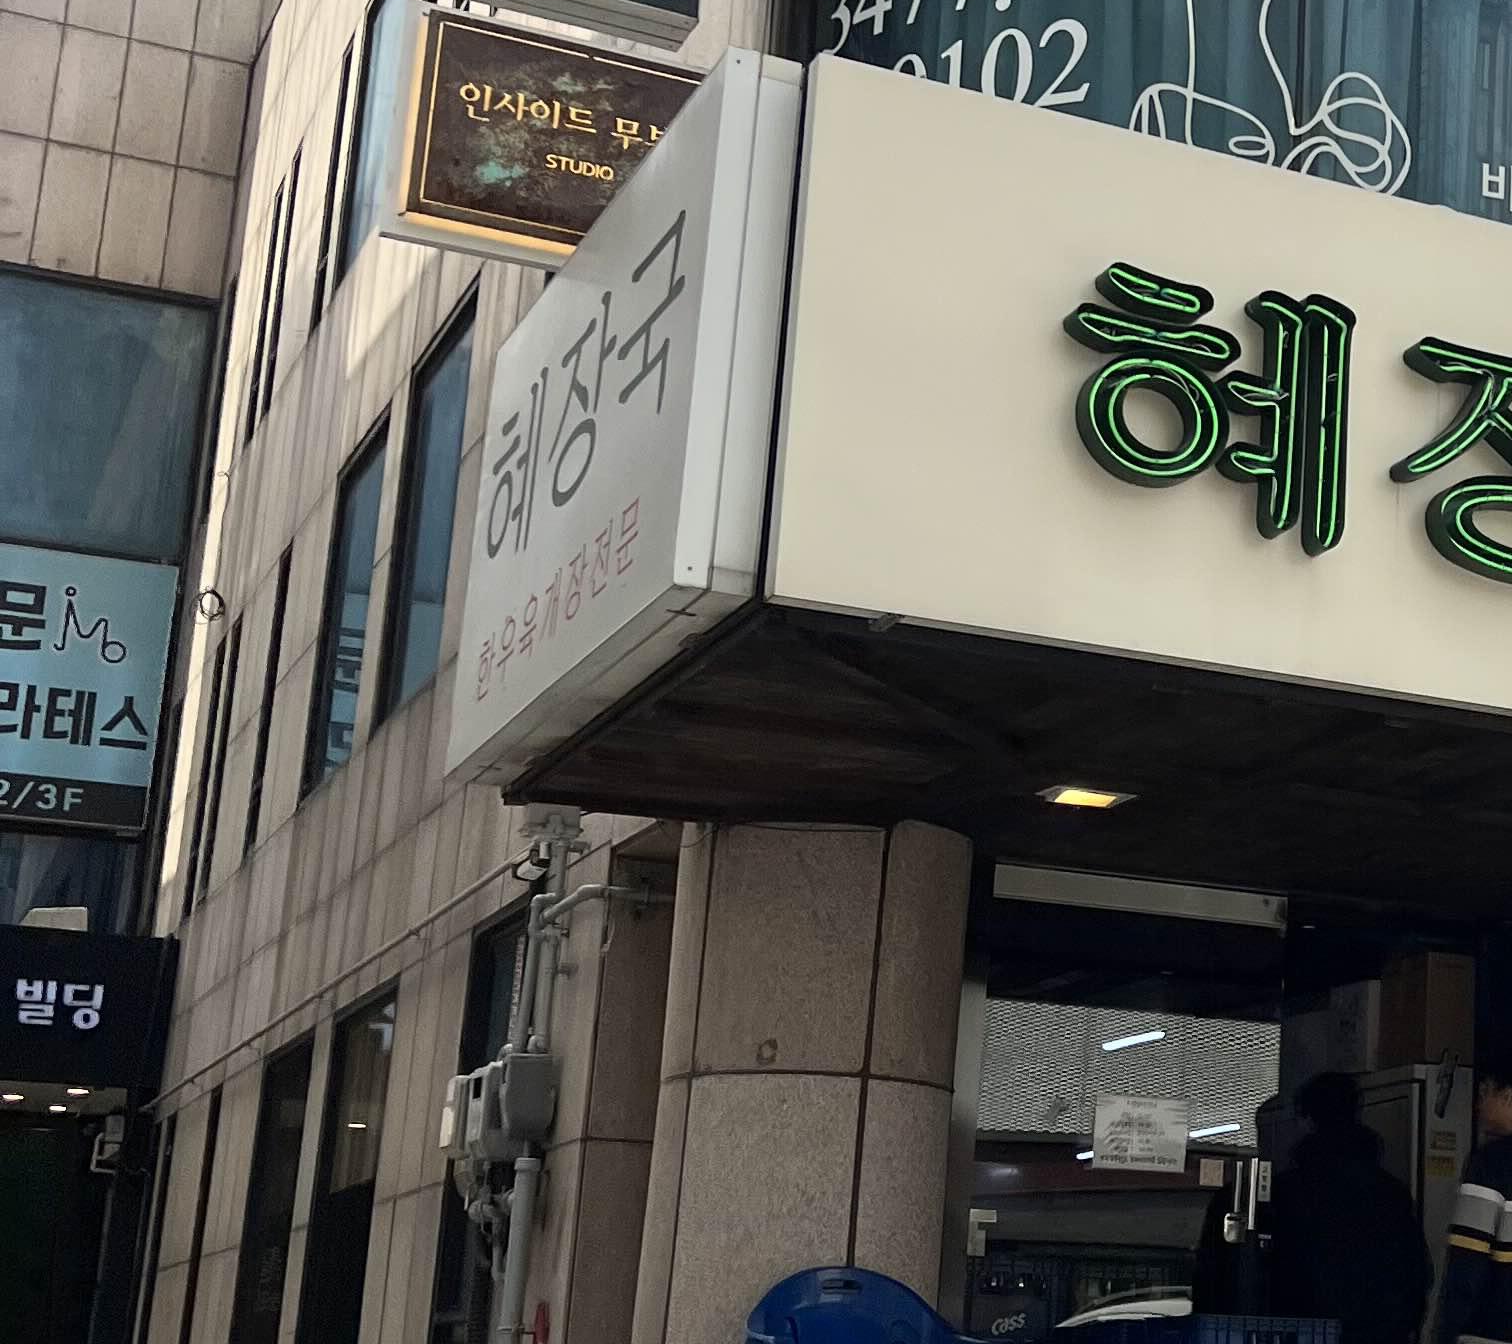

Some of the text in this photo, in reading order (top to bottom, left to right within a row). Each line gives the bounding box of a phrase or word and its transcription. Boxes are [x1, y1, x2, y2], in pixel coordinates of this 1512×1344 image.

[458, 82, 597, 135] 인사이드
[545, 152, 615, 182] STUDIO
[486, 209, 687, 559] 혜장국
[476, 496, 642, 703] 한우육개장전문
[15, 977, 105, 1031] 빌딩
